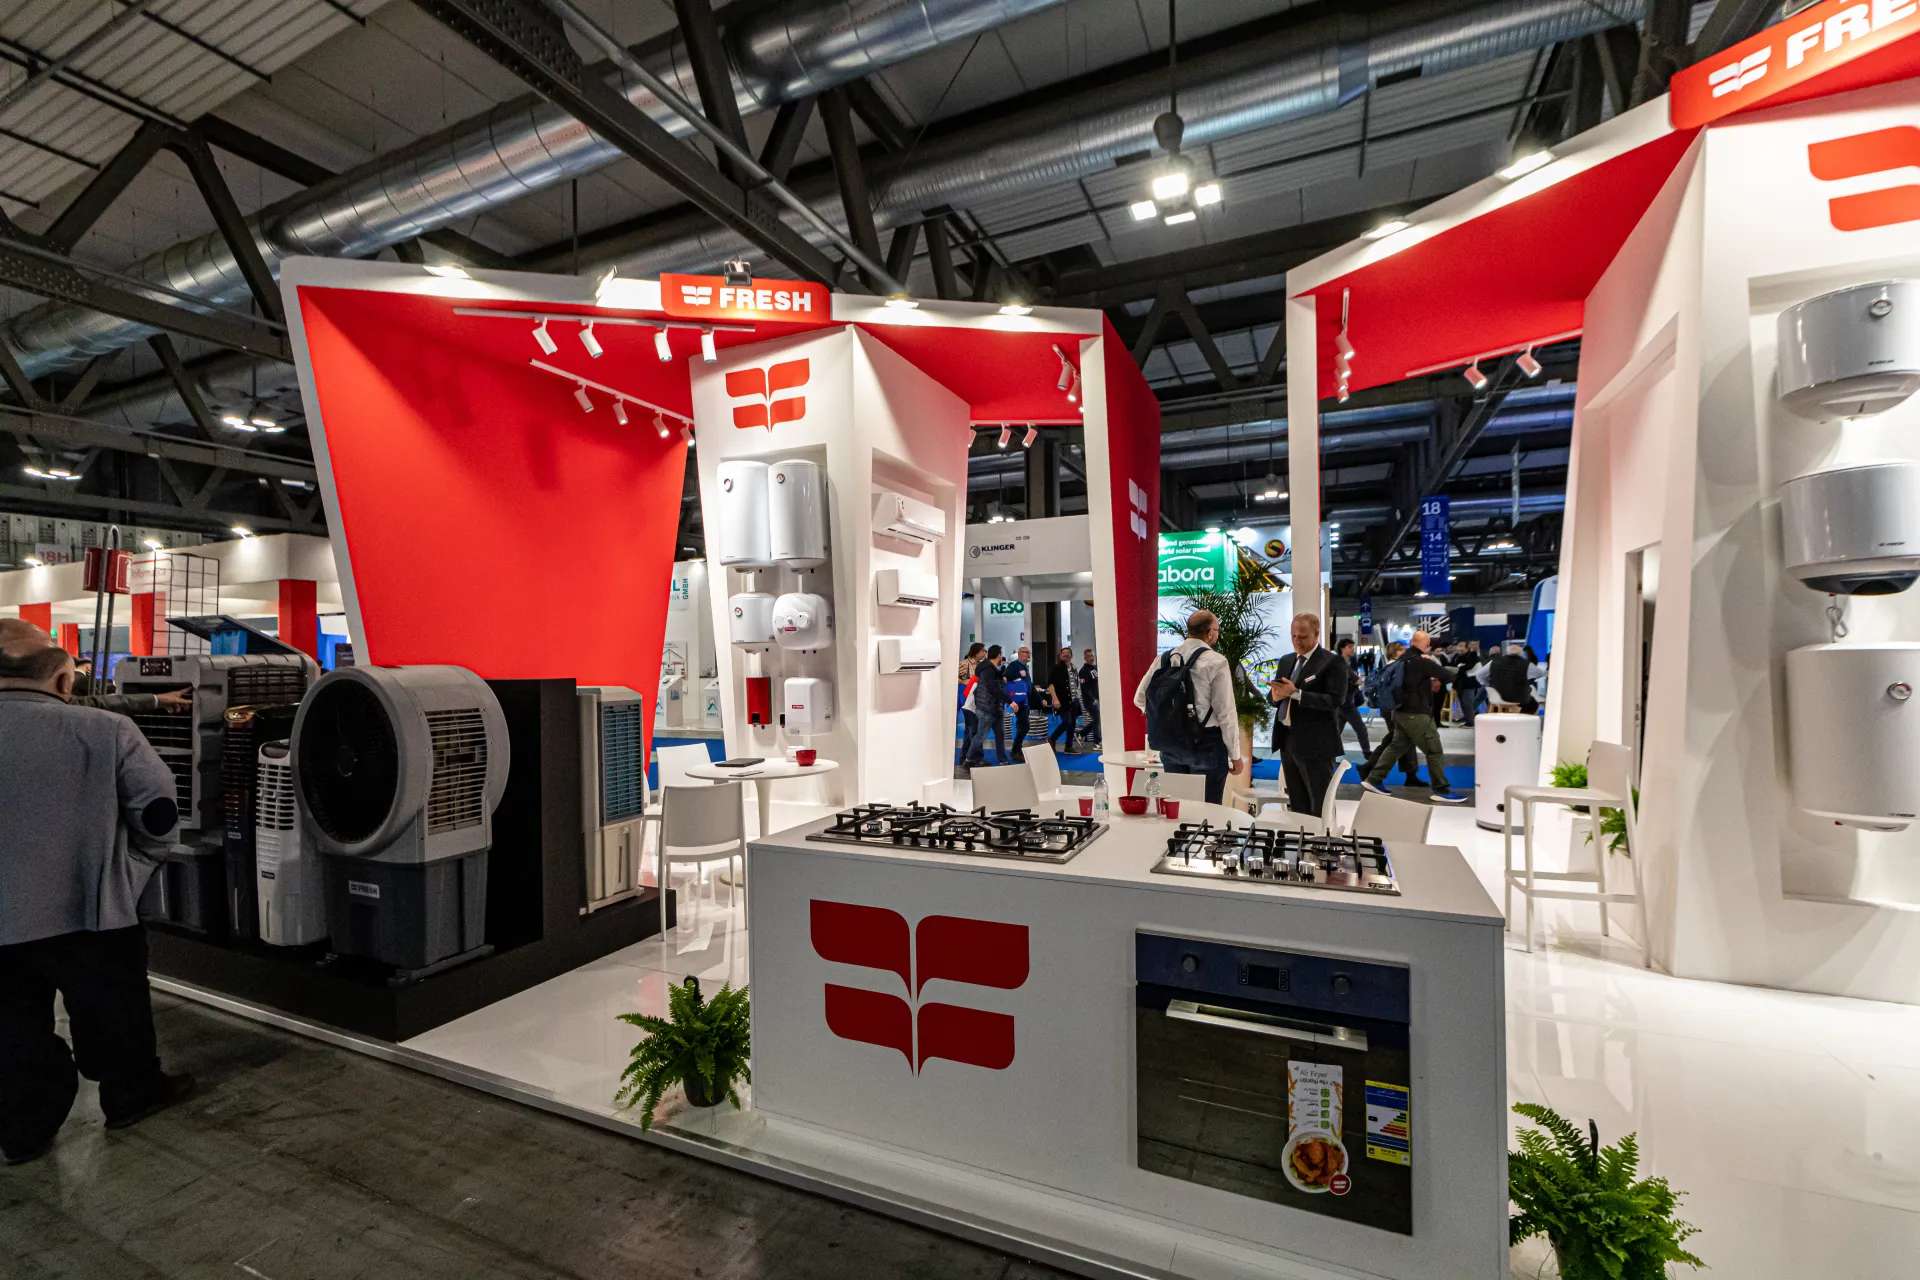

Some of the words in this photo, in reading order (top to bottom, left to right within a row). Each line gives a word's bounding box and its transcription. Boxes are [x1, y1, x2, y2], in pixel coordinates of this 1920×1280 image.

[1786, 0, 1920, 70] FRE
[719, 287, 812, 312] FRESH
[1422, 502, 1441, 515] 18
[1429, 533, 1442, 541] 14
[40, 551, 70, 563] 18H
[1158, 565, 1214, 583] abora
